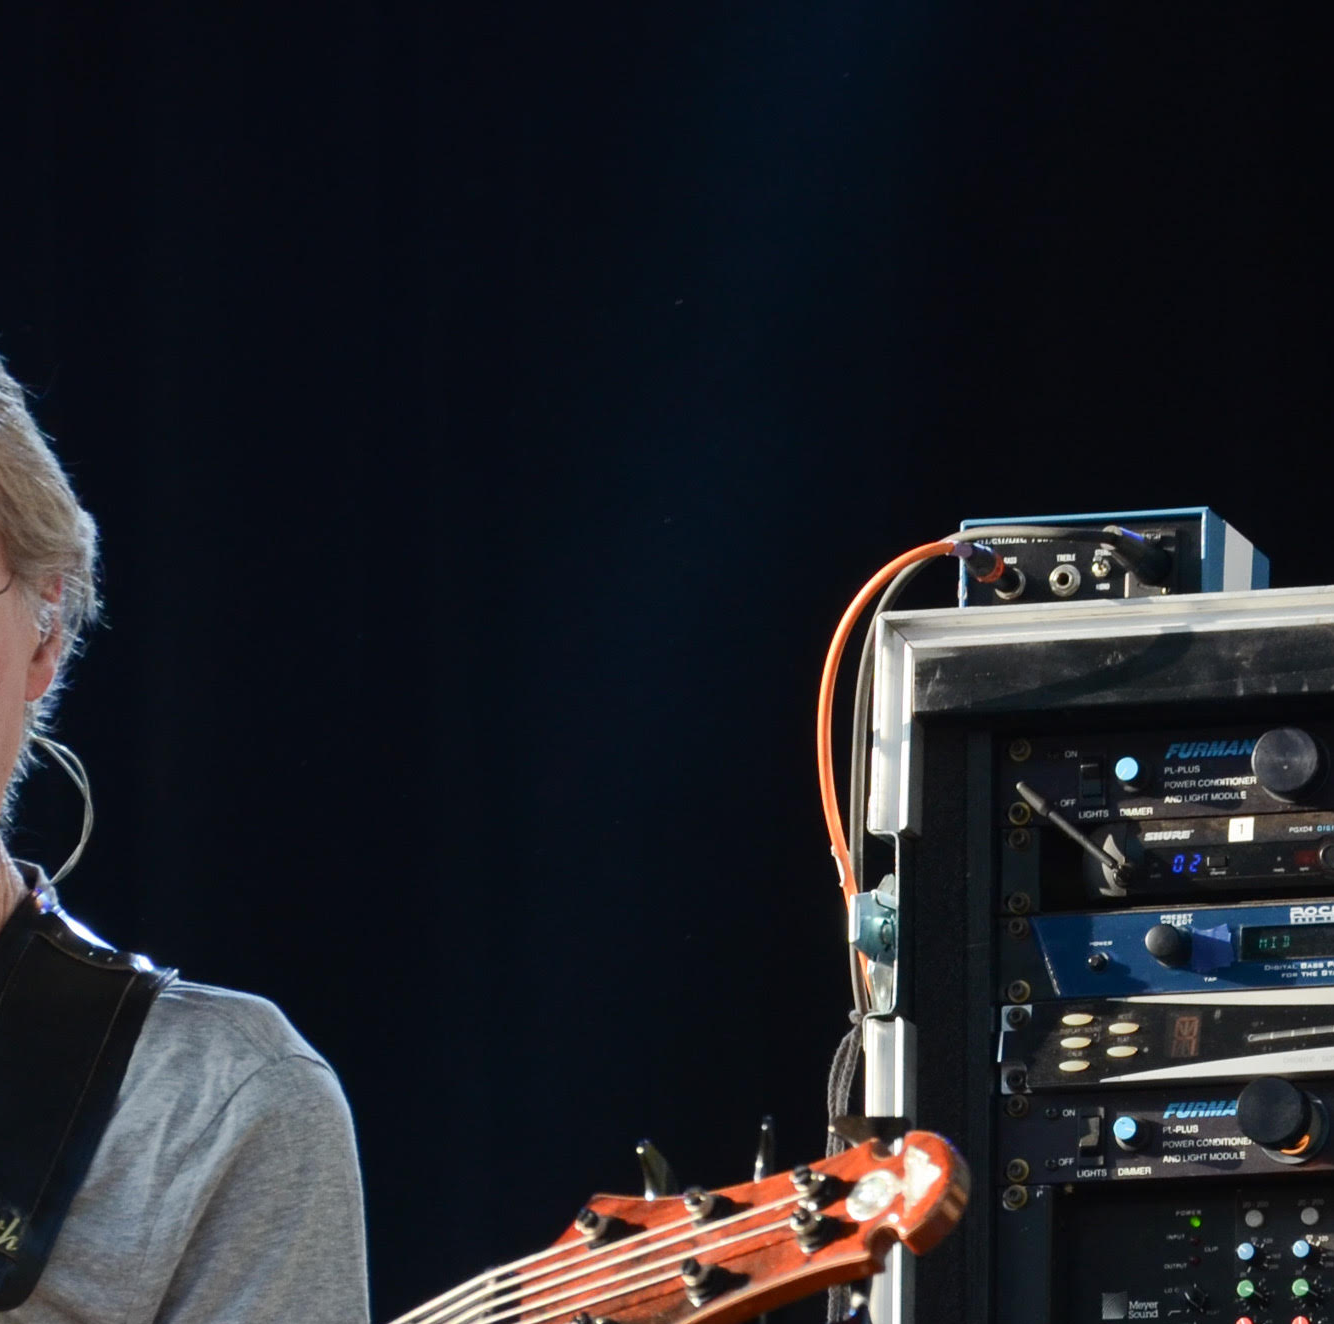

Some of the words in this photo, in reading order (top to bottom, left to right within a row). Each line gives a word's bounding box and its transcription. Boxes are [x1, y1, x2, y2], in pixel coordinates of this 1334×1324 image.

[1164, 739, 1257, 760] FURMAN
[1064, 751, 1078, 759] ON
[1164, 765, 1201, 775] PL-PLUS
[1164, 779, 1197, 789] POWER
[1197, 776, 1257, 787] CONDITIONER
[1163, 794, 1183, 804] AND
[1184, 793, 1209, 803] LIGHT
[1210, 790, 1247, 801] MODULE
[1059, 799, 1077, 808] OFF
[1078, 810, 1109, 819] LIGHTS
[1119, 807, 1154, 817] DIMMER
[1172, 853, 1203, 874] 02
[1062, 1109, 1076, 1117] ON
[1162, 1125, 1199, 1135] PL-PLUS
[1162, 1139, 1195, 1148] POWER
[1058, 1157, 1075, 1167] OFF
[1162, 1154, 1181, 1164] AND
[1182, 1153, 1208, 1163] LIGHT
[1209, 1151, 1246, 1161] MODULE
[1076, 1169, 1108, 1178] LIGHTS
[1117, 1166, 1152, 1177] DIMMER
[1128, 1301, 1159, 1311] Meyer
[1128, 1309, 1159, 1319] Sound
